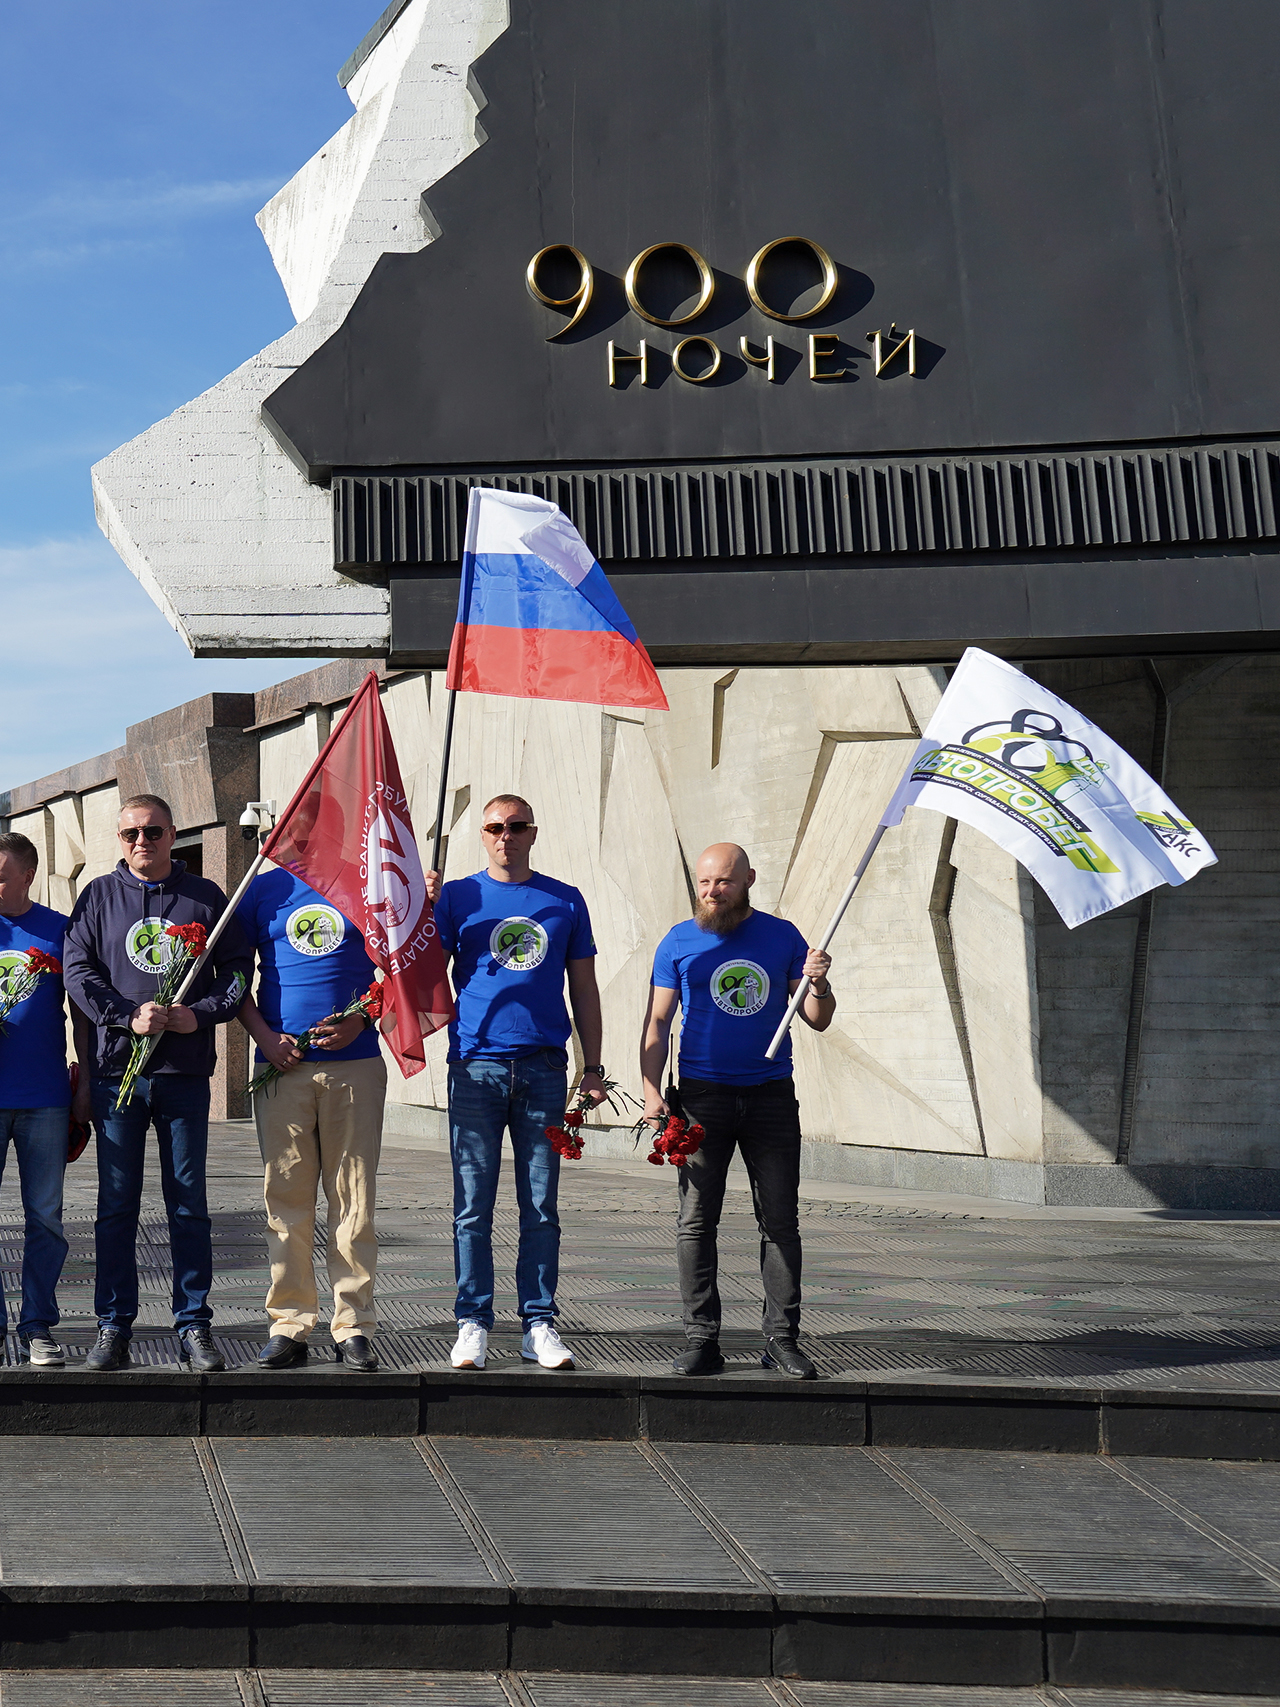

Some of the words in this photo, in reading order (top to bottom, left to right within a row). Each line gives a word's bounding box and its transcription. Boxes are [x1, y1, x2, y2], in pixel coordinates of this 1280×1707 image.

[527, 236, 838, 341] 900
[608, 322, 916, 387] НОЧЕЙ
[912, 752, 1097, 859] АВТОПРОБЕГ
[1008, 810, 1059, 852] САНКТ-ПЕТЕРБУРГ
[292, 937, 341, 954] АВТОПРОБЕГ
[494, 954, 543, 969] АВТОПРОБЕГ
[714, 996, 764, 1015] АВТОПРОБЕГ
